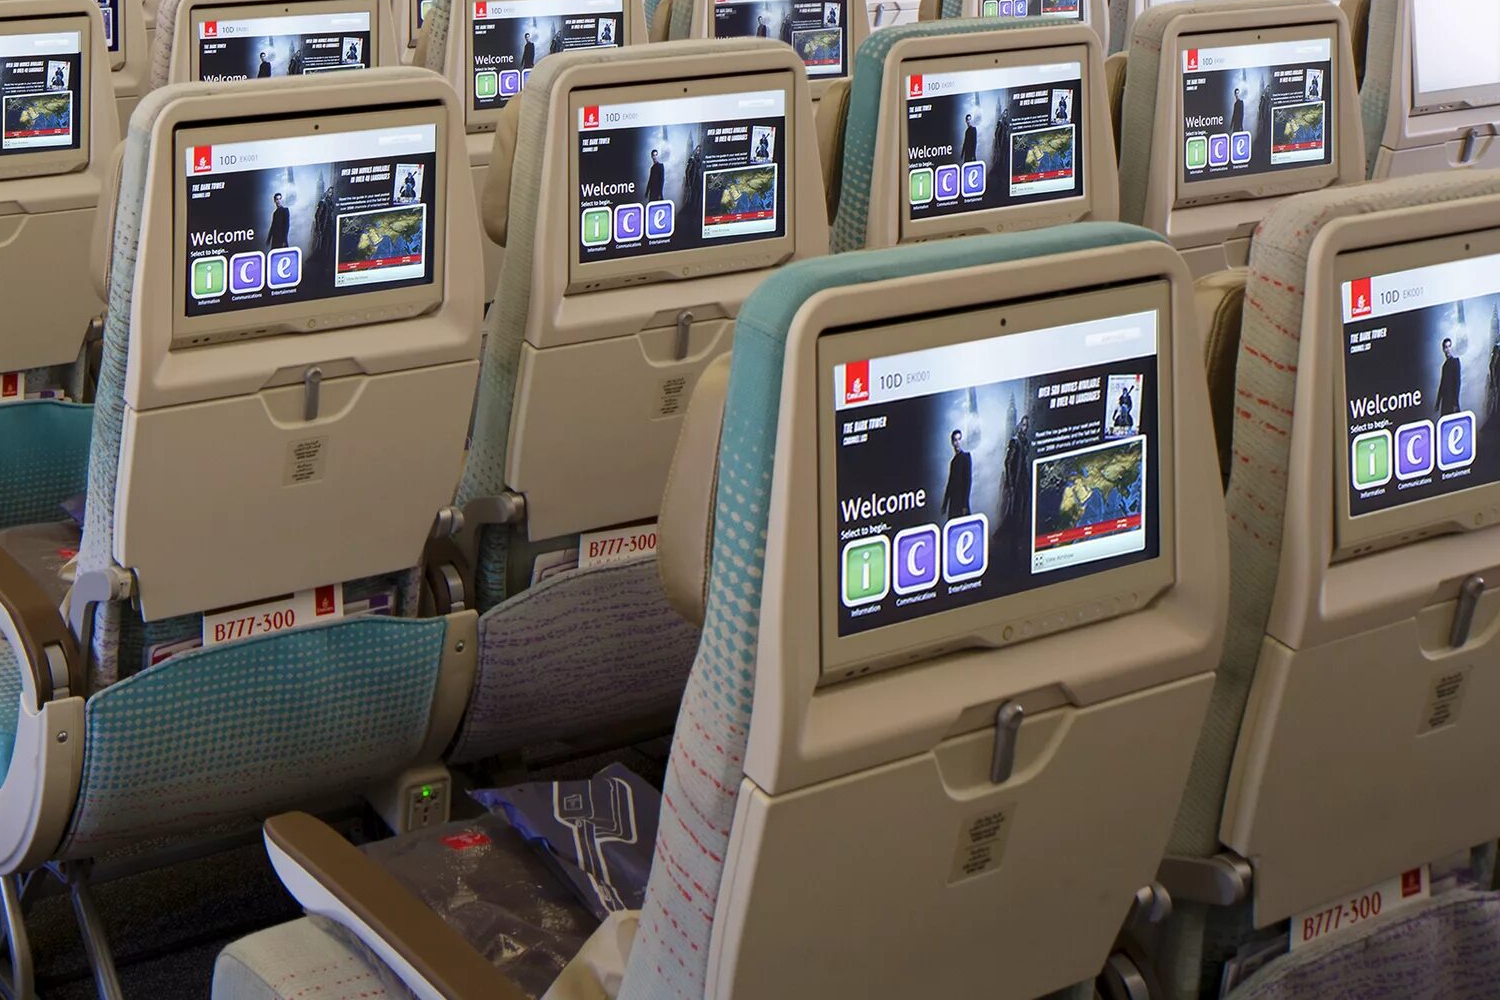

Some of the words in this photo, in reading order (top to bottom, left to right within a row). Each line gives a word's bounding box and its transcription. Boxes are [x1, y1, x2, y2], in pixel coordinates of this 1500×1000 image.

[475, 55, 513, 65] Welcome
[929, 82, 940, 91] 10D
[606, 113, 620, 122] 10D
[1186, 116, 1223, 128] Welcome
[220, 156, 237, 165] 10D
[908, 145, 952, 160] Welcome
[581, 182, 635, 197] Welcome
[595, 216, 599, 237] i
[654, 209, 665, 229] e
[191, 229, 254, 246] Welcome
[207, 266, 212, 289] i
[277, 257, 291, 278] e
[1381, 290, 1399, 304] 10D
[1403, 287, 1423, 299] EK001
[880, 374, 902, 389] 10D
[907, 371, 929, 384] EK001
[1351, 390, 1421, 418] Welcome
[1370, 444, 1375, 475] i
[1448, 426, 1464, 454] e
[1361, 489, 1385, 498] Information
[1398, 478, 1432, 490] Communications
[1442, 468, 1471, 480] Entertainment
[842, 490, 925, 522] Welcome
[590, 532, 657, 558] B777-300
[863, 552, 869, 589] i
[956, 531, 974, 564] e
[852, 605, 881, 617] Information
[896, 592, 936, 606] Communications
[215, 609, 295, 642] B777-300
[1303, 892, 1382, 941] B777-300
